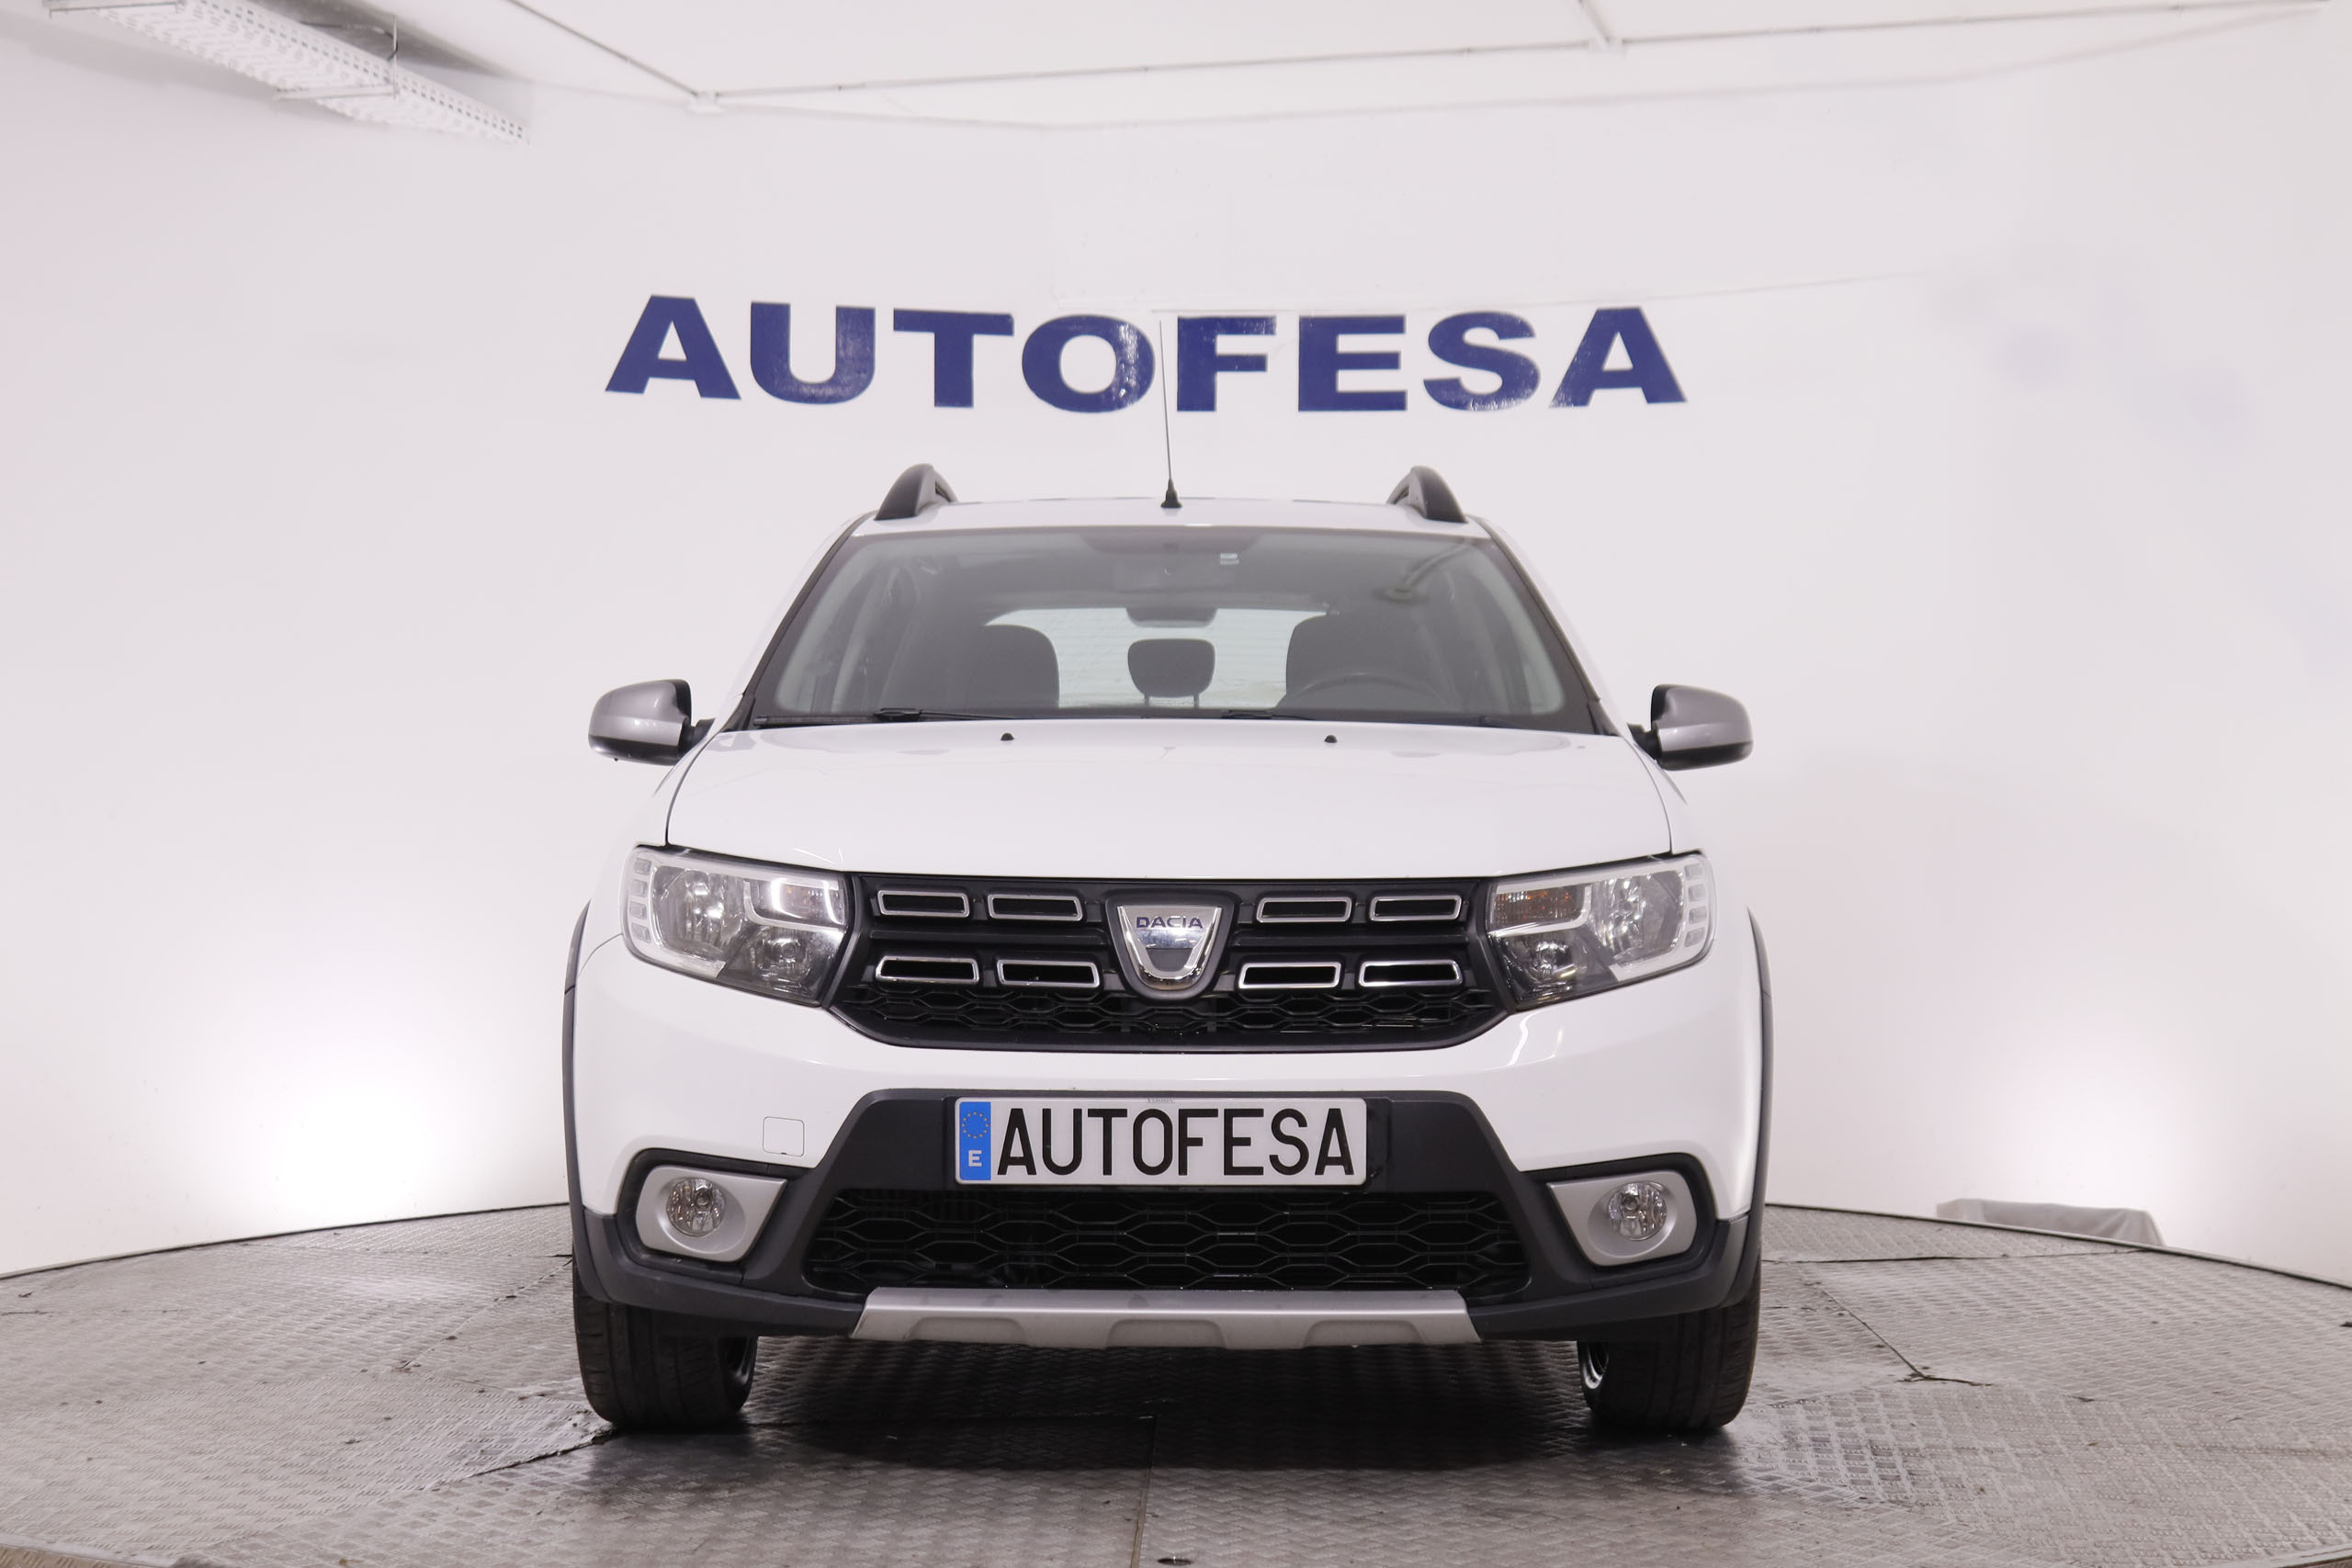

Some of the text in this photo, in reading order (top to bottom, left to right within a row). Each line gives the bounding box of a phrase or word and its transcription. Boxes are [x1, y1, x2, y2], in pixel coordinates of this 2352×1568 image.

[605, 294, 1688, 413] AUTOFESA
[1136, 916, 1204, 929] DACIA
[967, 1149, 983, 1168] E
[997, 1108, 1355, 1176] AUTOFESA
